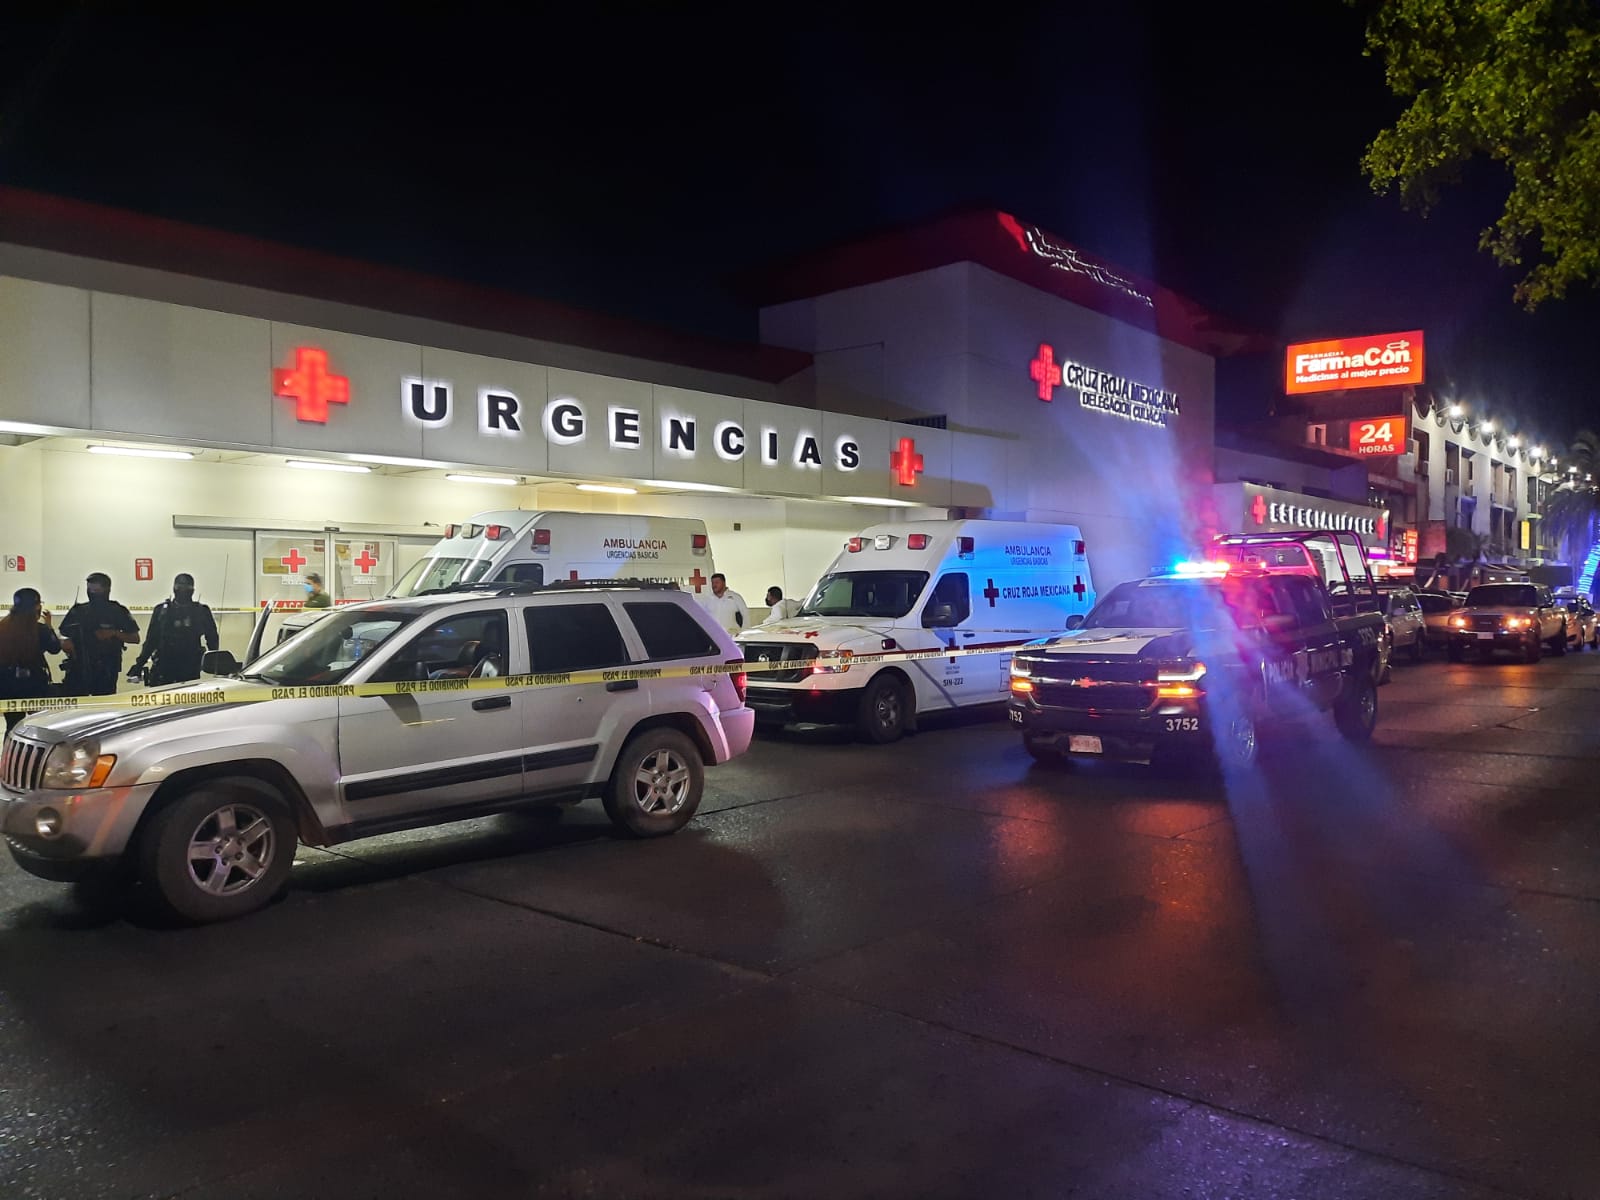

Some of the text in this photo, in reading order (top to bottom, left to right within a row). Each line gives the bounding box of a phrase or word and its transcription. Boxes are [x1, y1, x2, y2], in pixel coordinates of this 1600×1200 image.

[1296, 373, 1338, 383] Medicinas
[1351, 368, 1377, 378] mejor
[1379, 366, 1409, 376] precio
[1066, 363, 1180, 414] CRUZ ROJA MEXICANA
[410, 383, 859, 469] URGENCIAS
[1360, 422, 1392, 444] 24
[1359, 444, 1394, 454] HORAS
[603, 538, 668, 550] AMBULANCIA
[1005, 545, 1051, 556] AMBULANCIA
[606, 550, 636, 559] URGENCIAS
[1003, 585, 1070, 599] CRUZ ROJA MEXICANA
[1166, 718, 1198, 731] 3752
